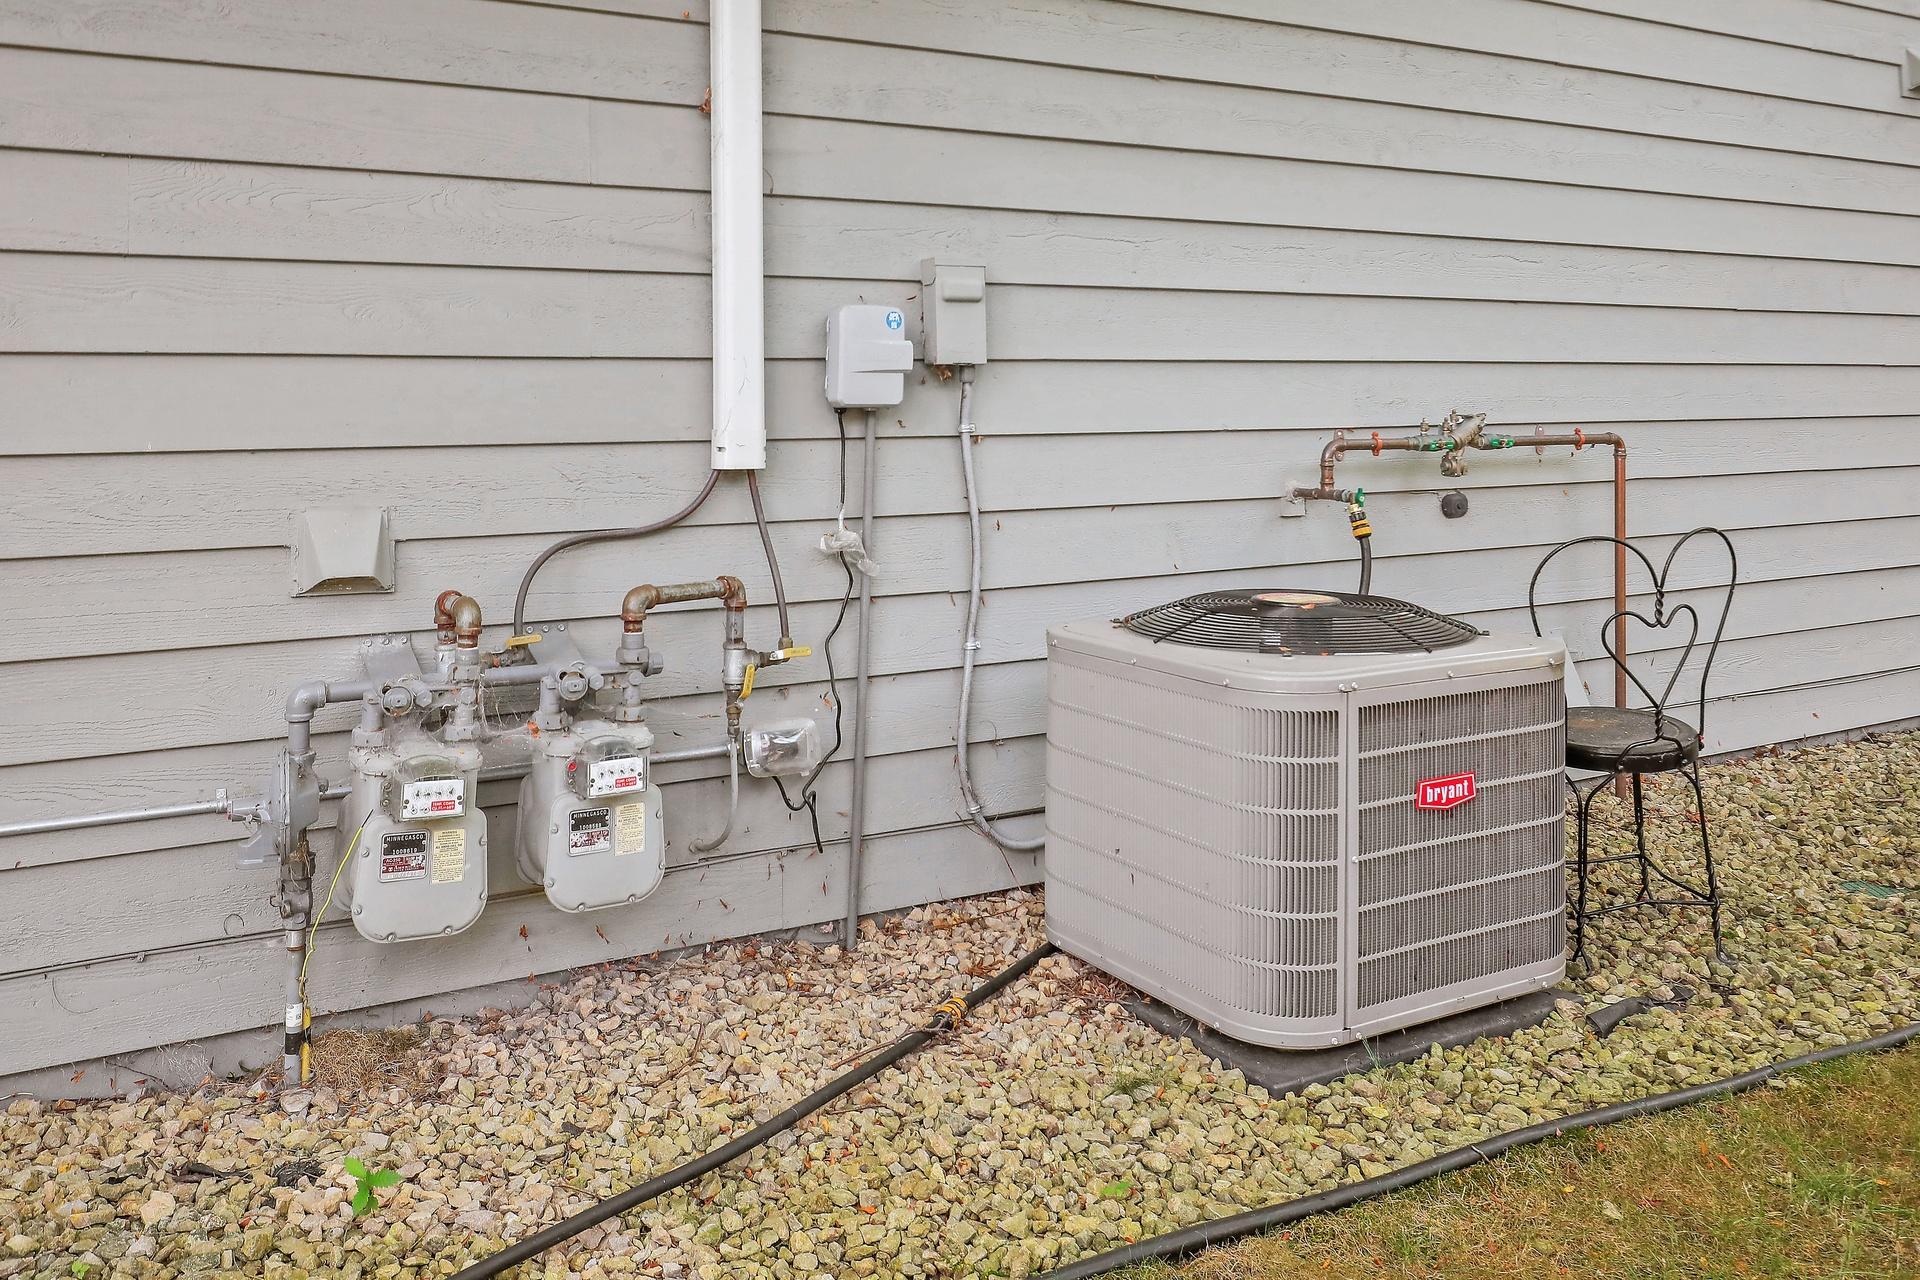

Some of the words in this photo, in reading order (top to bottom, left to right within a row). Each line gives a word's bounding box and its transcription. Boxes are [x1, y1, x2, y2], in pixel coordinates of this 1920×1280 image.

[1426, 780, 1469, 803] bryant
[573, 809, 607, 819] MINNEGASCO
[386, 834, 424, 842] MINNEGASCO
